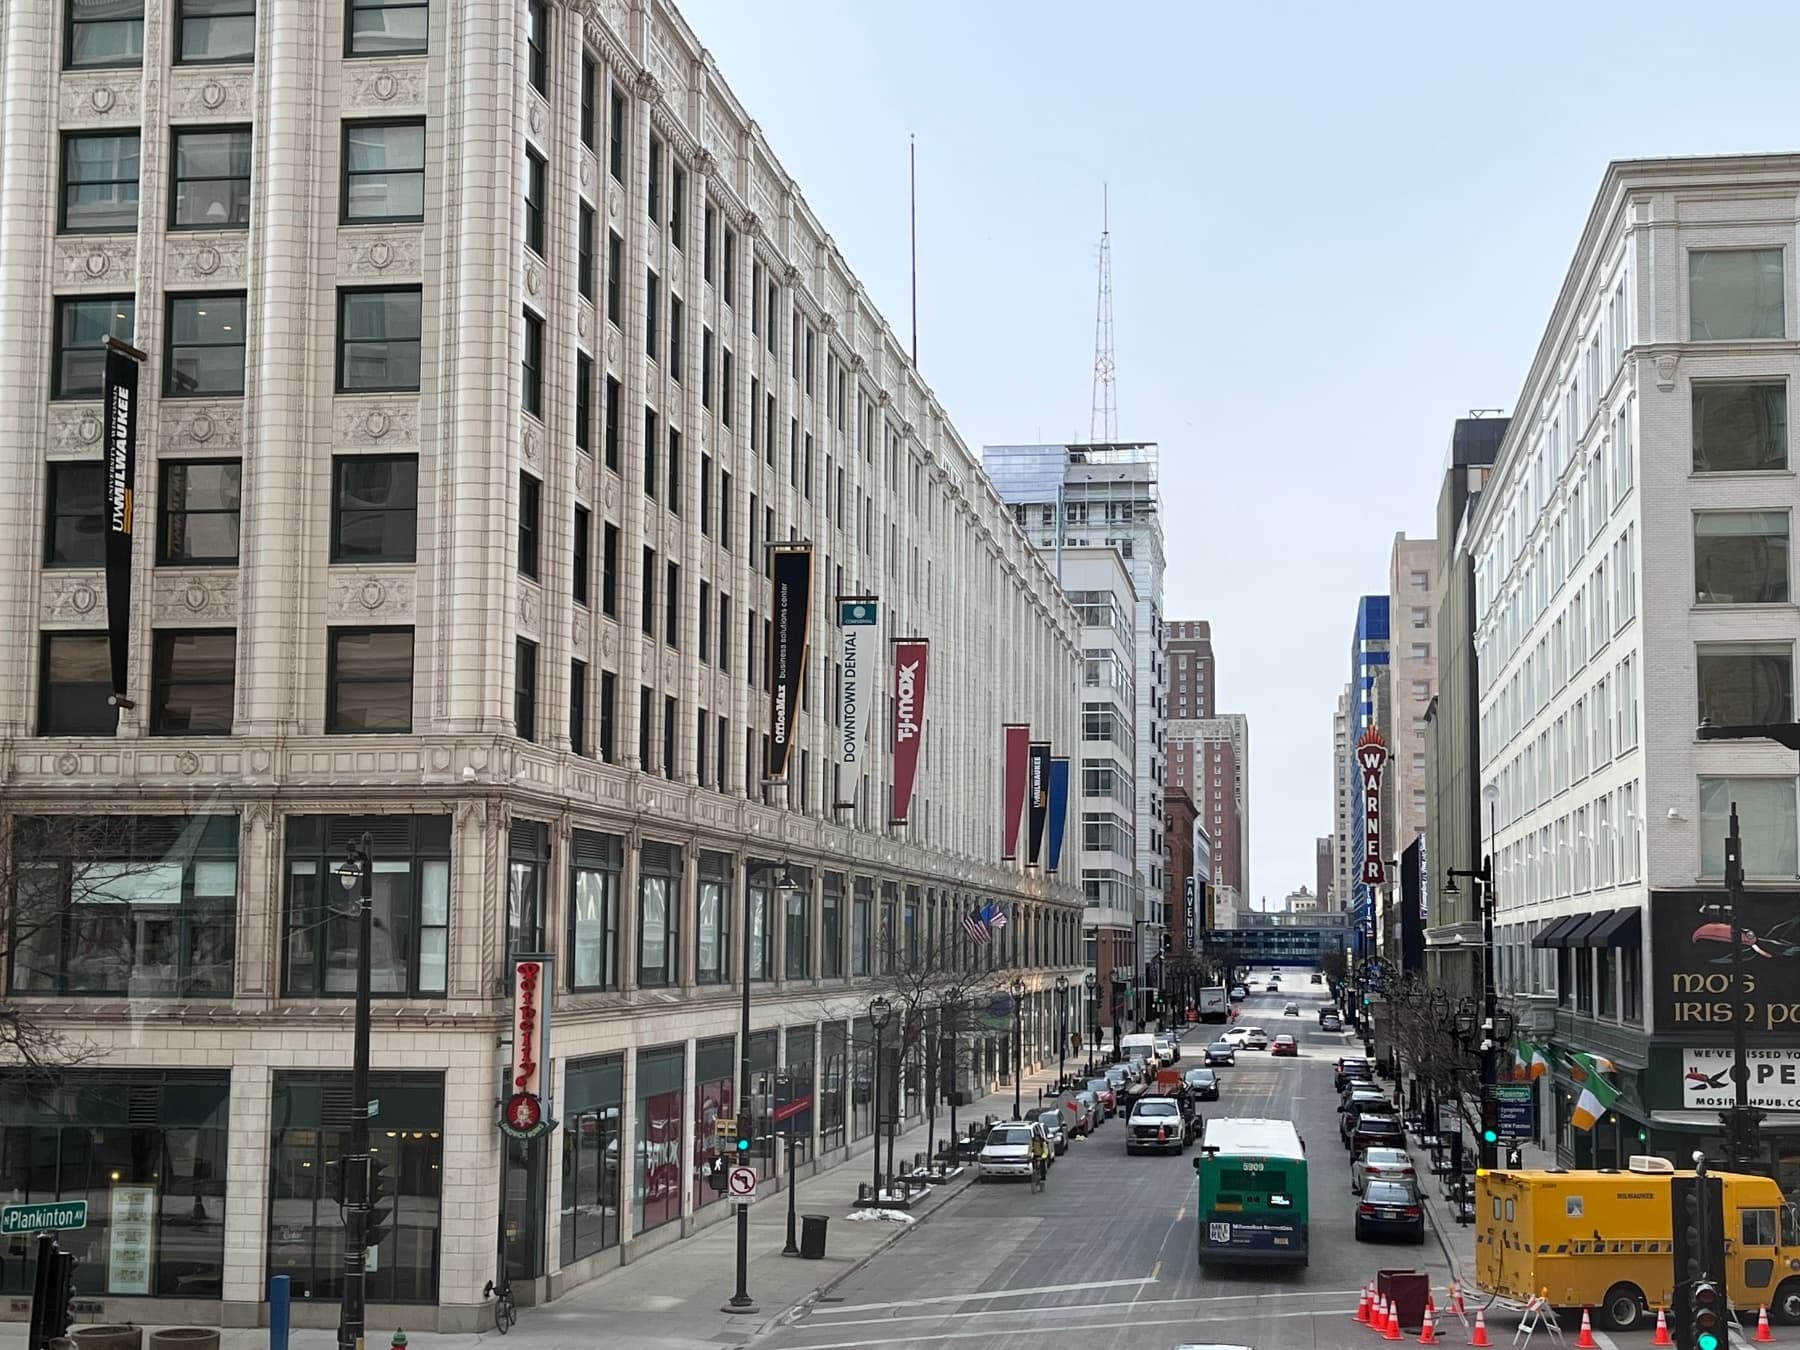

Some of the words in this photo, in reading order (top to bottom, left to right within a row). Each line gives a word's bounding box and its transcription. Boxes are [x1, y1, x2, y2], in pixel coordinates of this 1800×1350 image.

[780, 582, 788, 607] center
[779, 643, 787, 679] business
[844, 631, 857, 679] DENTAL
[775, 684, 786, 744] OfficeMax
[844, 682, 856, 763] DOWNTOWN
[1363, 753, 1381, 878] WARNER
[1186, 886, 1194, 949] AVENUE
[515, 963, 540, 1087] Potbelly
[1694, 1050, 1732, 1058] WE'VE
[1243, 1163, 1265, 1171] 5909
[4, 1216, 10, 1225] N
[10, 1208, 73, 1229] Plankinton
[74, 1209, 83, 1220] AV
